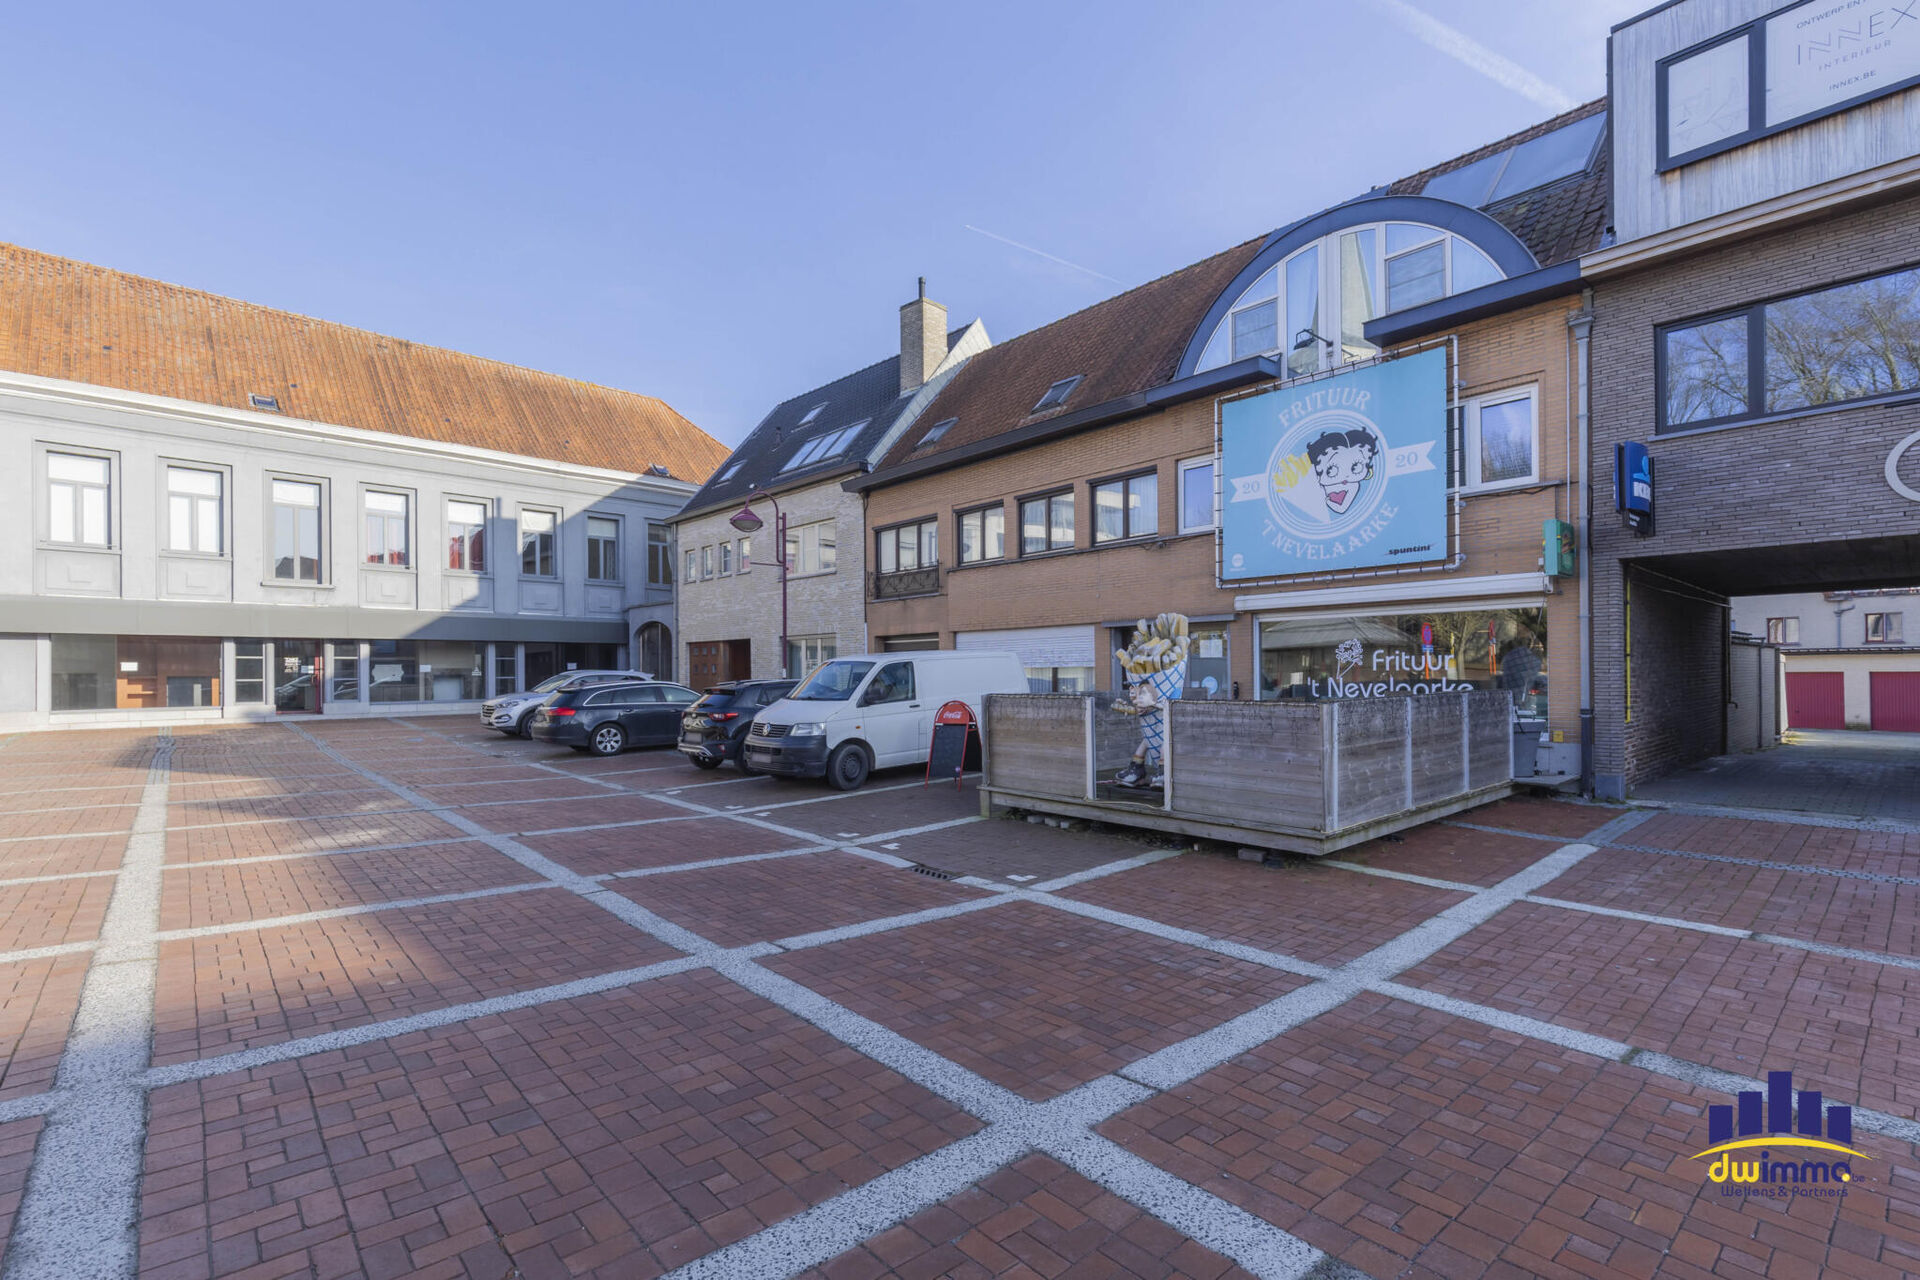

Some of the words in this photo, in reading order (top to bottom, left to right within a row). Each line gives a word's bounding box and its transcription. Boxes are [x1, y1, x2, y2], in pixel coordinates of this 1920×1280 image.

[1796, 5, 1845, 29] ONTWERP
[1797, 0, 1918, 65] INNEX
[1818, 39, 1891, 71] INTERIEUR
[1829, 70, 1877, 90] INNEX.BE
[1278, 387, 1371, 427] FRITUUR
[1394, 451, 1418, 468] 20
[1242, 479, 1260, 494] 20
[1388, 544, 1431, 556] spuntini
[1372, 649, 1455, 671] Frituur
